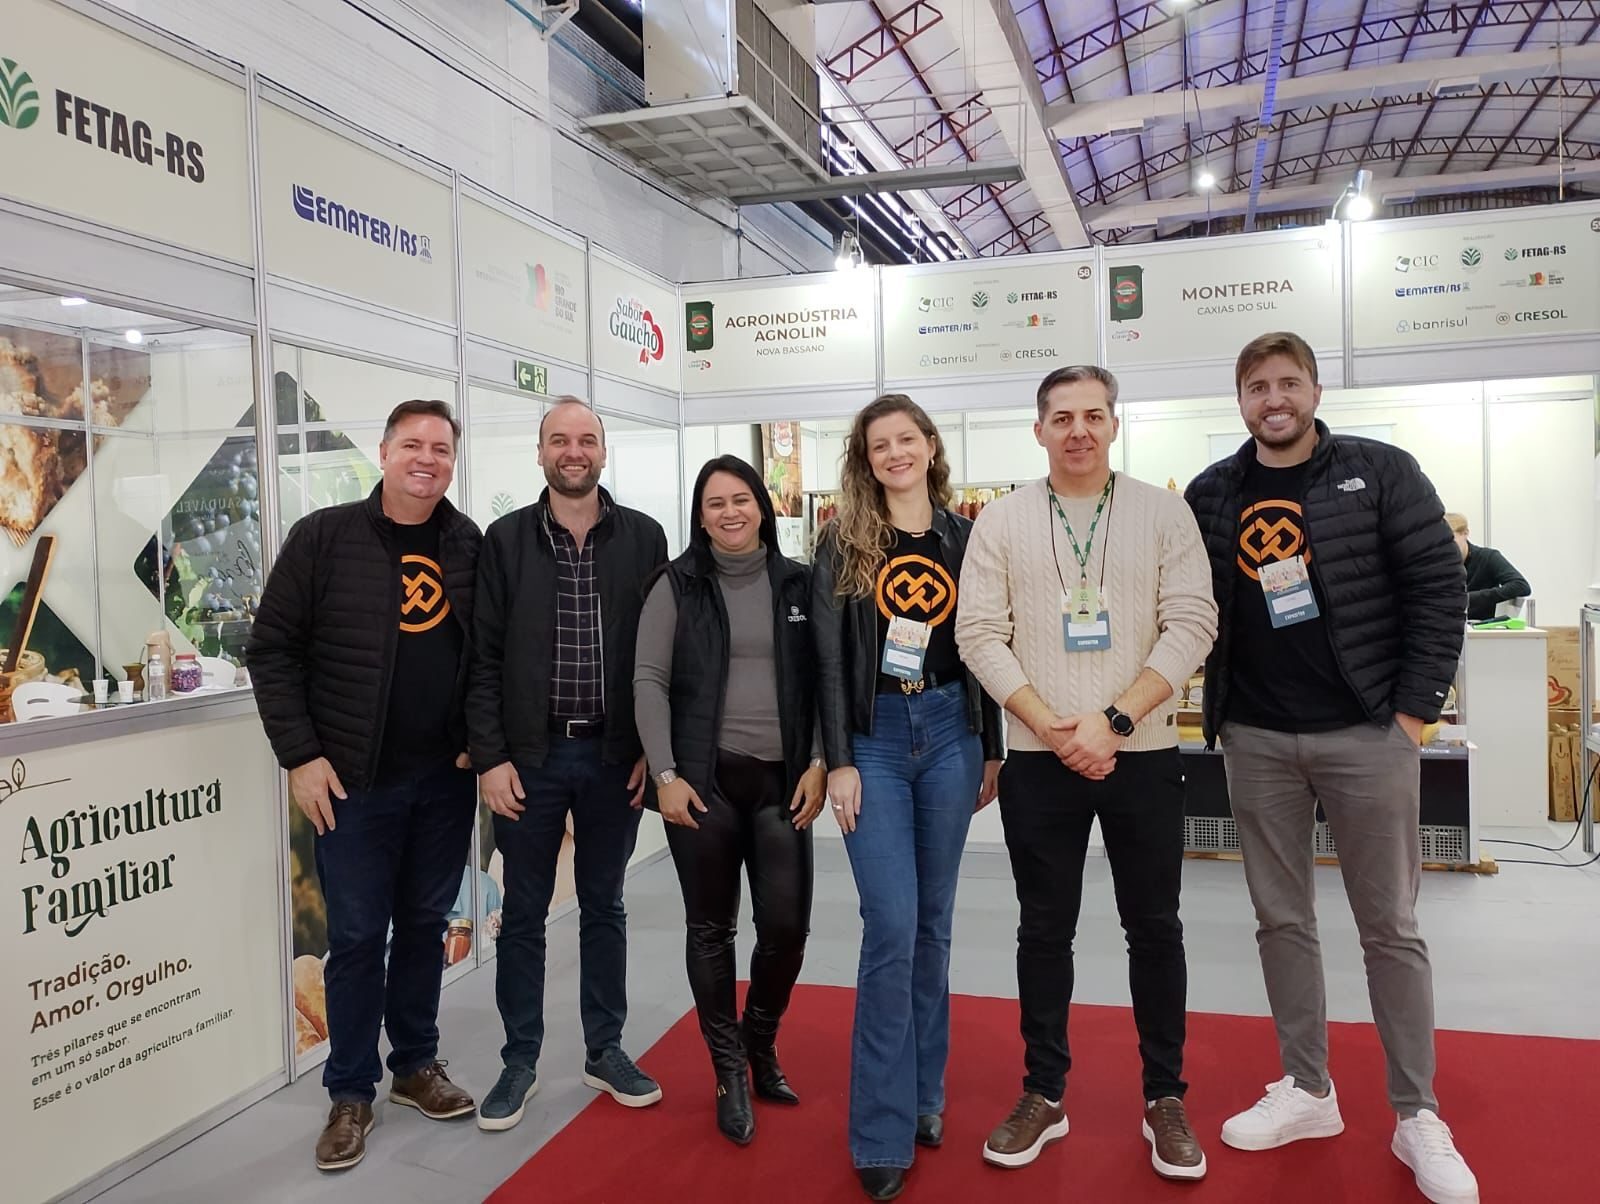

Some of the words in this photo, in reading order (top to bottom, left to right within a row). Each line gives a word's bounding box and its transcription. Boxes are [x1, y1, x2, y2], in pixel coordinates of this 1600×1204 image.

[55, 88, 206, 184] FETAG-RS
[316, 196, 417, 257] EMATER/RS
[1521, 245, 1567, 258] FETAG-RS
[1412, 255, 1439, 267] CIC
[1078, 268, 1090, 278] 58
[1021, 290, 1058, 301] FETAG-RS
[1182, 279, 1293, 301] MONTERRA
[1406, 283, 1461, 296] EMATER/RS
[616, 297, 643, 322] Sabor
[932, 297, 954, 308] CIC
[1197, 304, 1235, 315] CAXIAS
[1237, 303, 1254, 312] DO
[1256, 302, 1277, 311] SUL
[725, 307, 858, 328] AGROINDÚSTRIA
[1515, 308, 1568, 322] CRESOL
[927, 323, 972, 334] EMATER/RS
[1413, 316, 1468, 331] banrisul
[754, 326, 827, 342] AGNOLIN
[756, 347, 781, 356] NOVA
[783, 345, 824, 355] BASSANO
[1015, 348, 1059, 359] CRESOL
[933, 353, 978, 365] banrisul
[19, 778, 223, 879] Agricultura
[21, 853, 176, 938] Familiar
[28, 952, 131, 1001] Tradição.
[30, 995, 100, 1034] Amor.
[106, 956, 193, 1002] Orgulho.
[63, 1029, 104, 1056] pilares
[107, 1019, 127, 1036] que
[130, 1013, 142, 1025] se
[144, 987, 201, 1018] encontram
[31, 1070, 52, 1087] em
[55, 1060, 76, 1076] um
[78, 1051, 92, 1065] só
[33, 1089, 61, 1110] Esse
[65, 1082, 72, 1095] é
[74, 1080, 82, 1090] o
[85, 1064, 115, 1085] valor
[118, 1057, 132, 1069] da
[135, 1028, 193, 1061] agricultura
